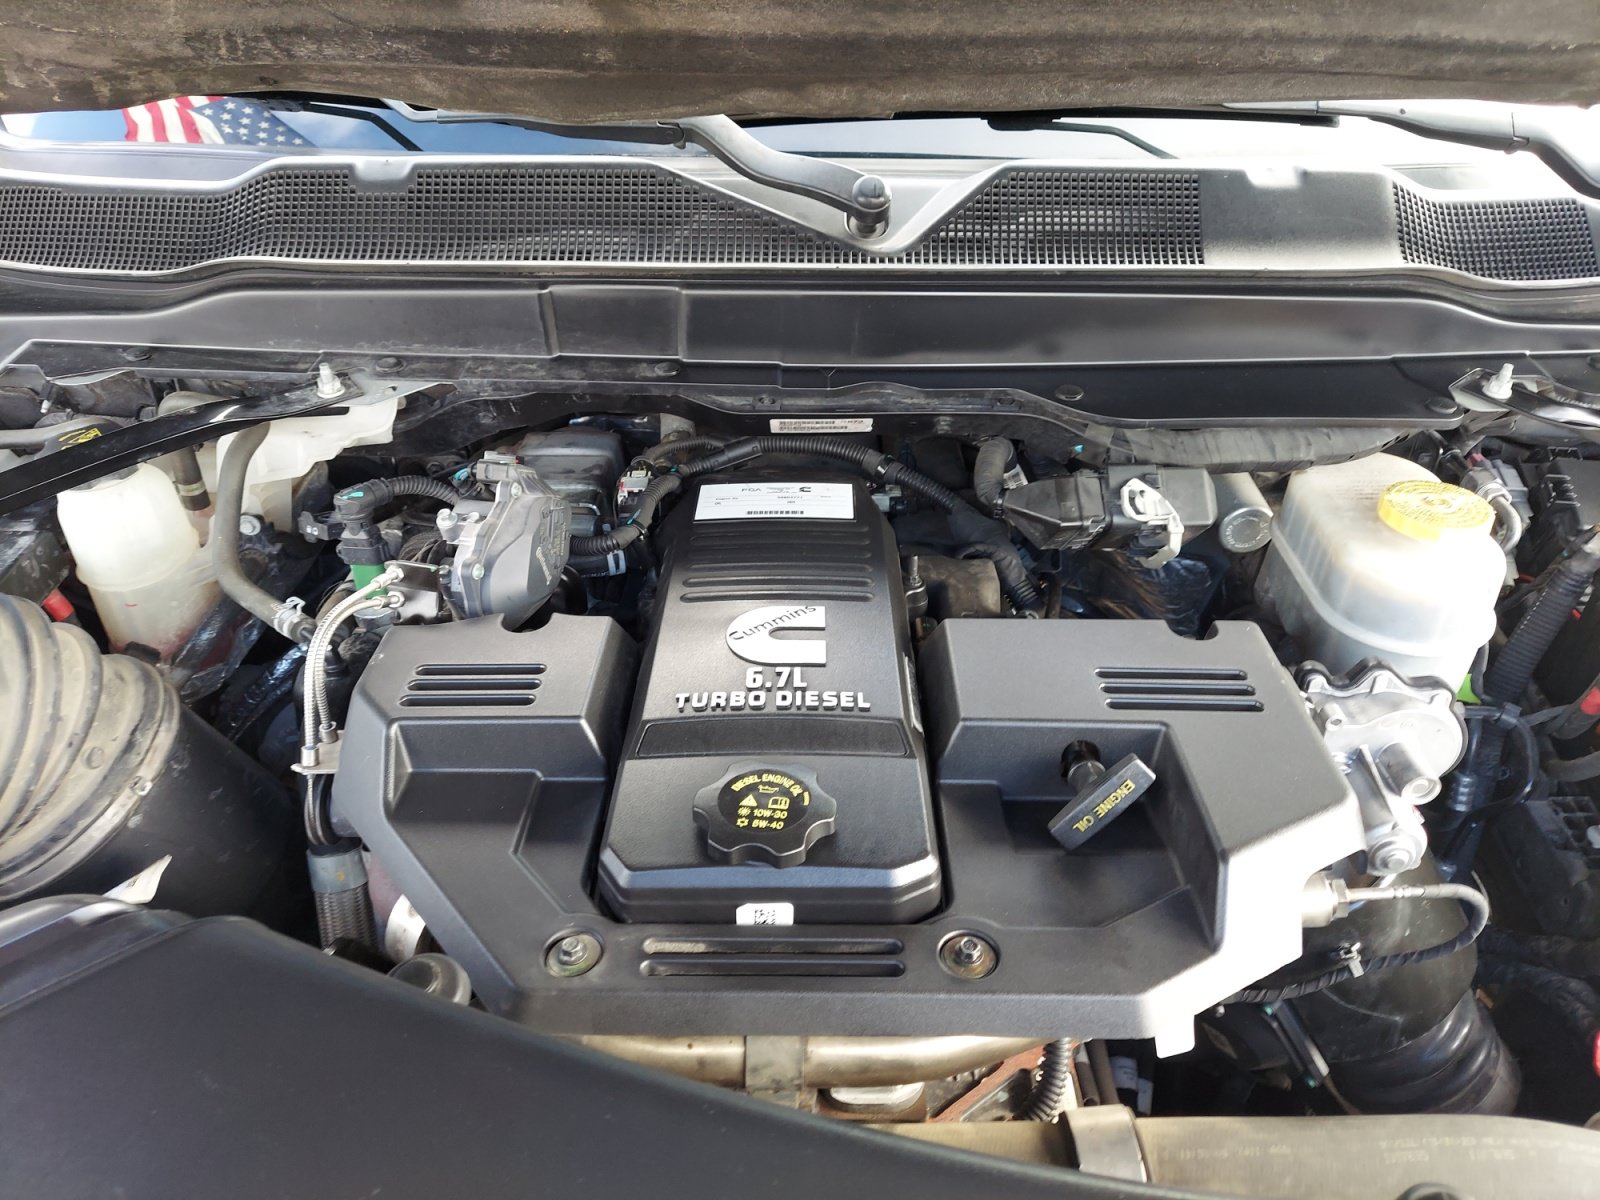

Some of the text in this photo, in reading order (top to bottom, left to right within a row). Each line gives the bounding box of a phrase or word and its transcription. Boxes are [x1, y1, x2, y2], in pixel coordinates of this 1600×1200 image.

[728, 604, 817, 640] Cummins
[745, 666, 807, 689] 6.7L
[675, 690, 871, 712] TURBO DIESEL
[730, 773, 803, 797] DIESEL ENGINE OIL
[752, 808, 788, 819] 10W-30
[1072, 778, 1136, 833] ENGINE OIL
[751, 819, 784, 830] 5W-40
